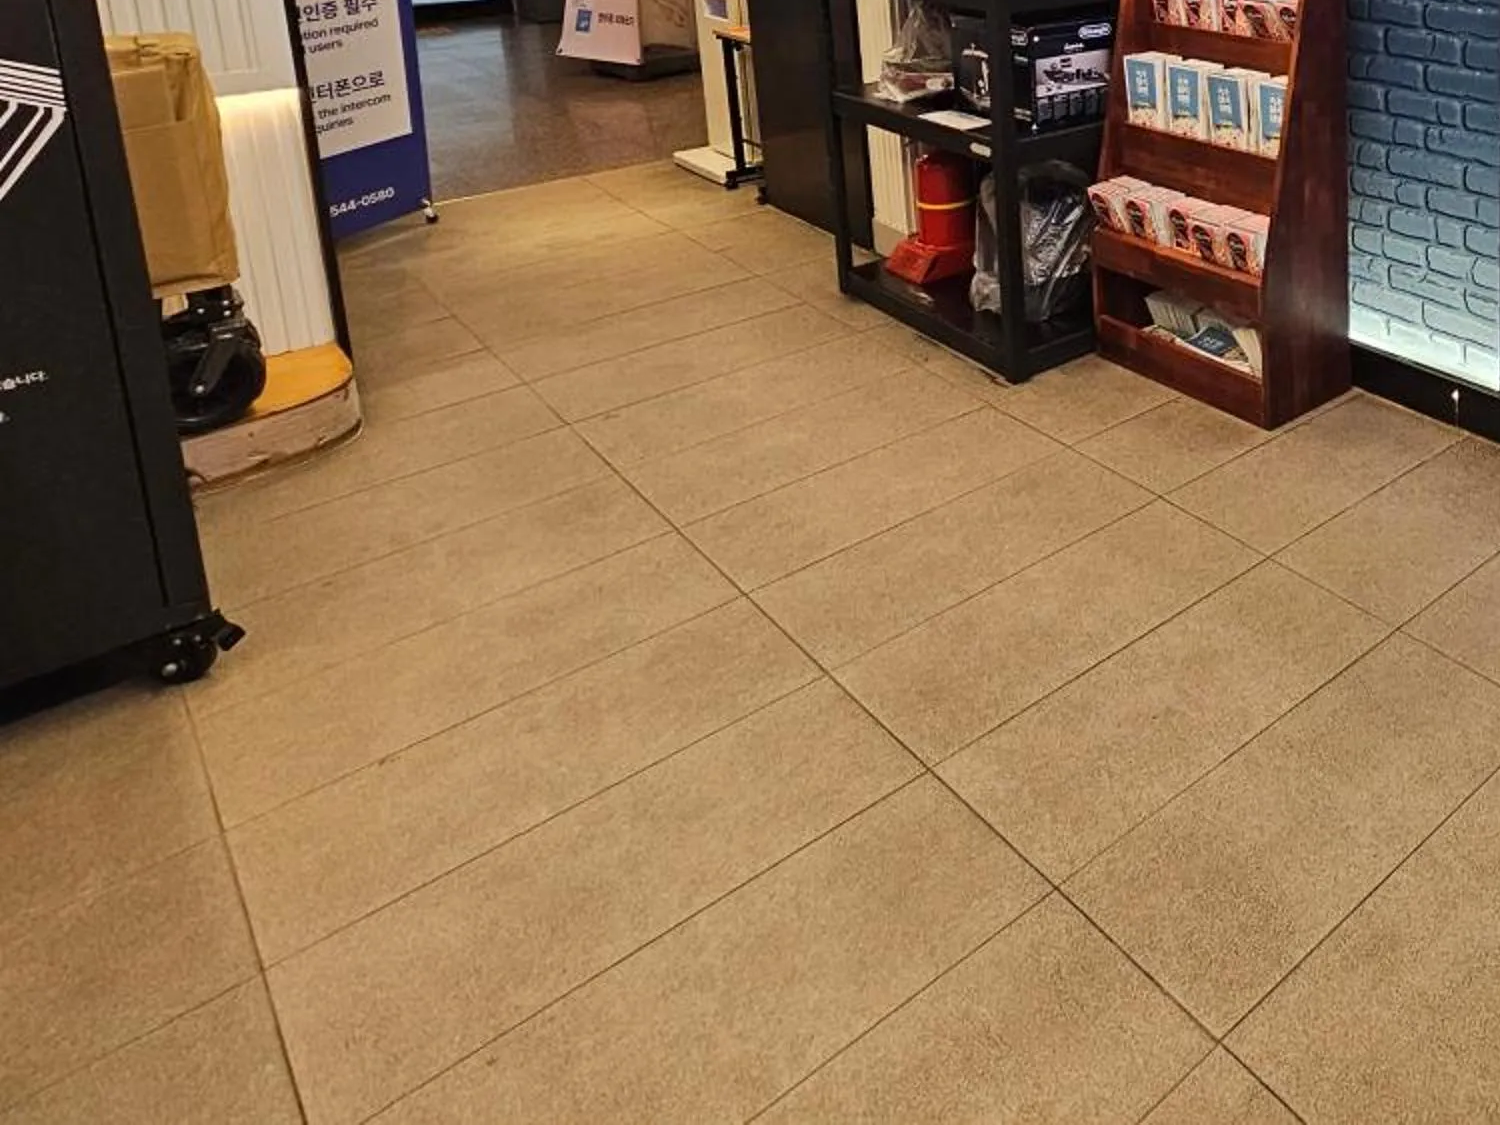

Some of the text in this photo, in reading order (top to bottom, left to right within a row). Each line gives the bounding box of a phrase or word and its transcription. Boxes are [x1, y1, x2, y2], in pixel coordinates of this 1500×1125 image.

[299, 0, 338, 23] 인증
[330, 18, 379, 36] required
[309, 39, 343, 54] users
[318, 94, 392, 120] the intercom
[329, 187, 396, 218] 544-0580
